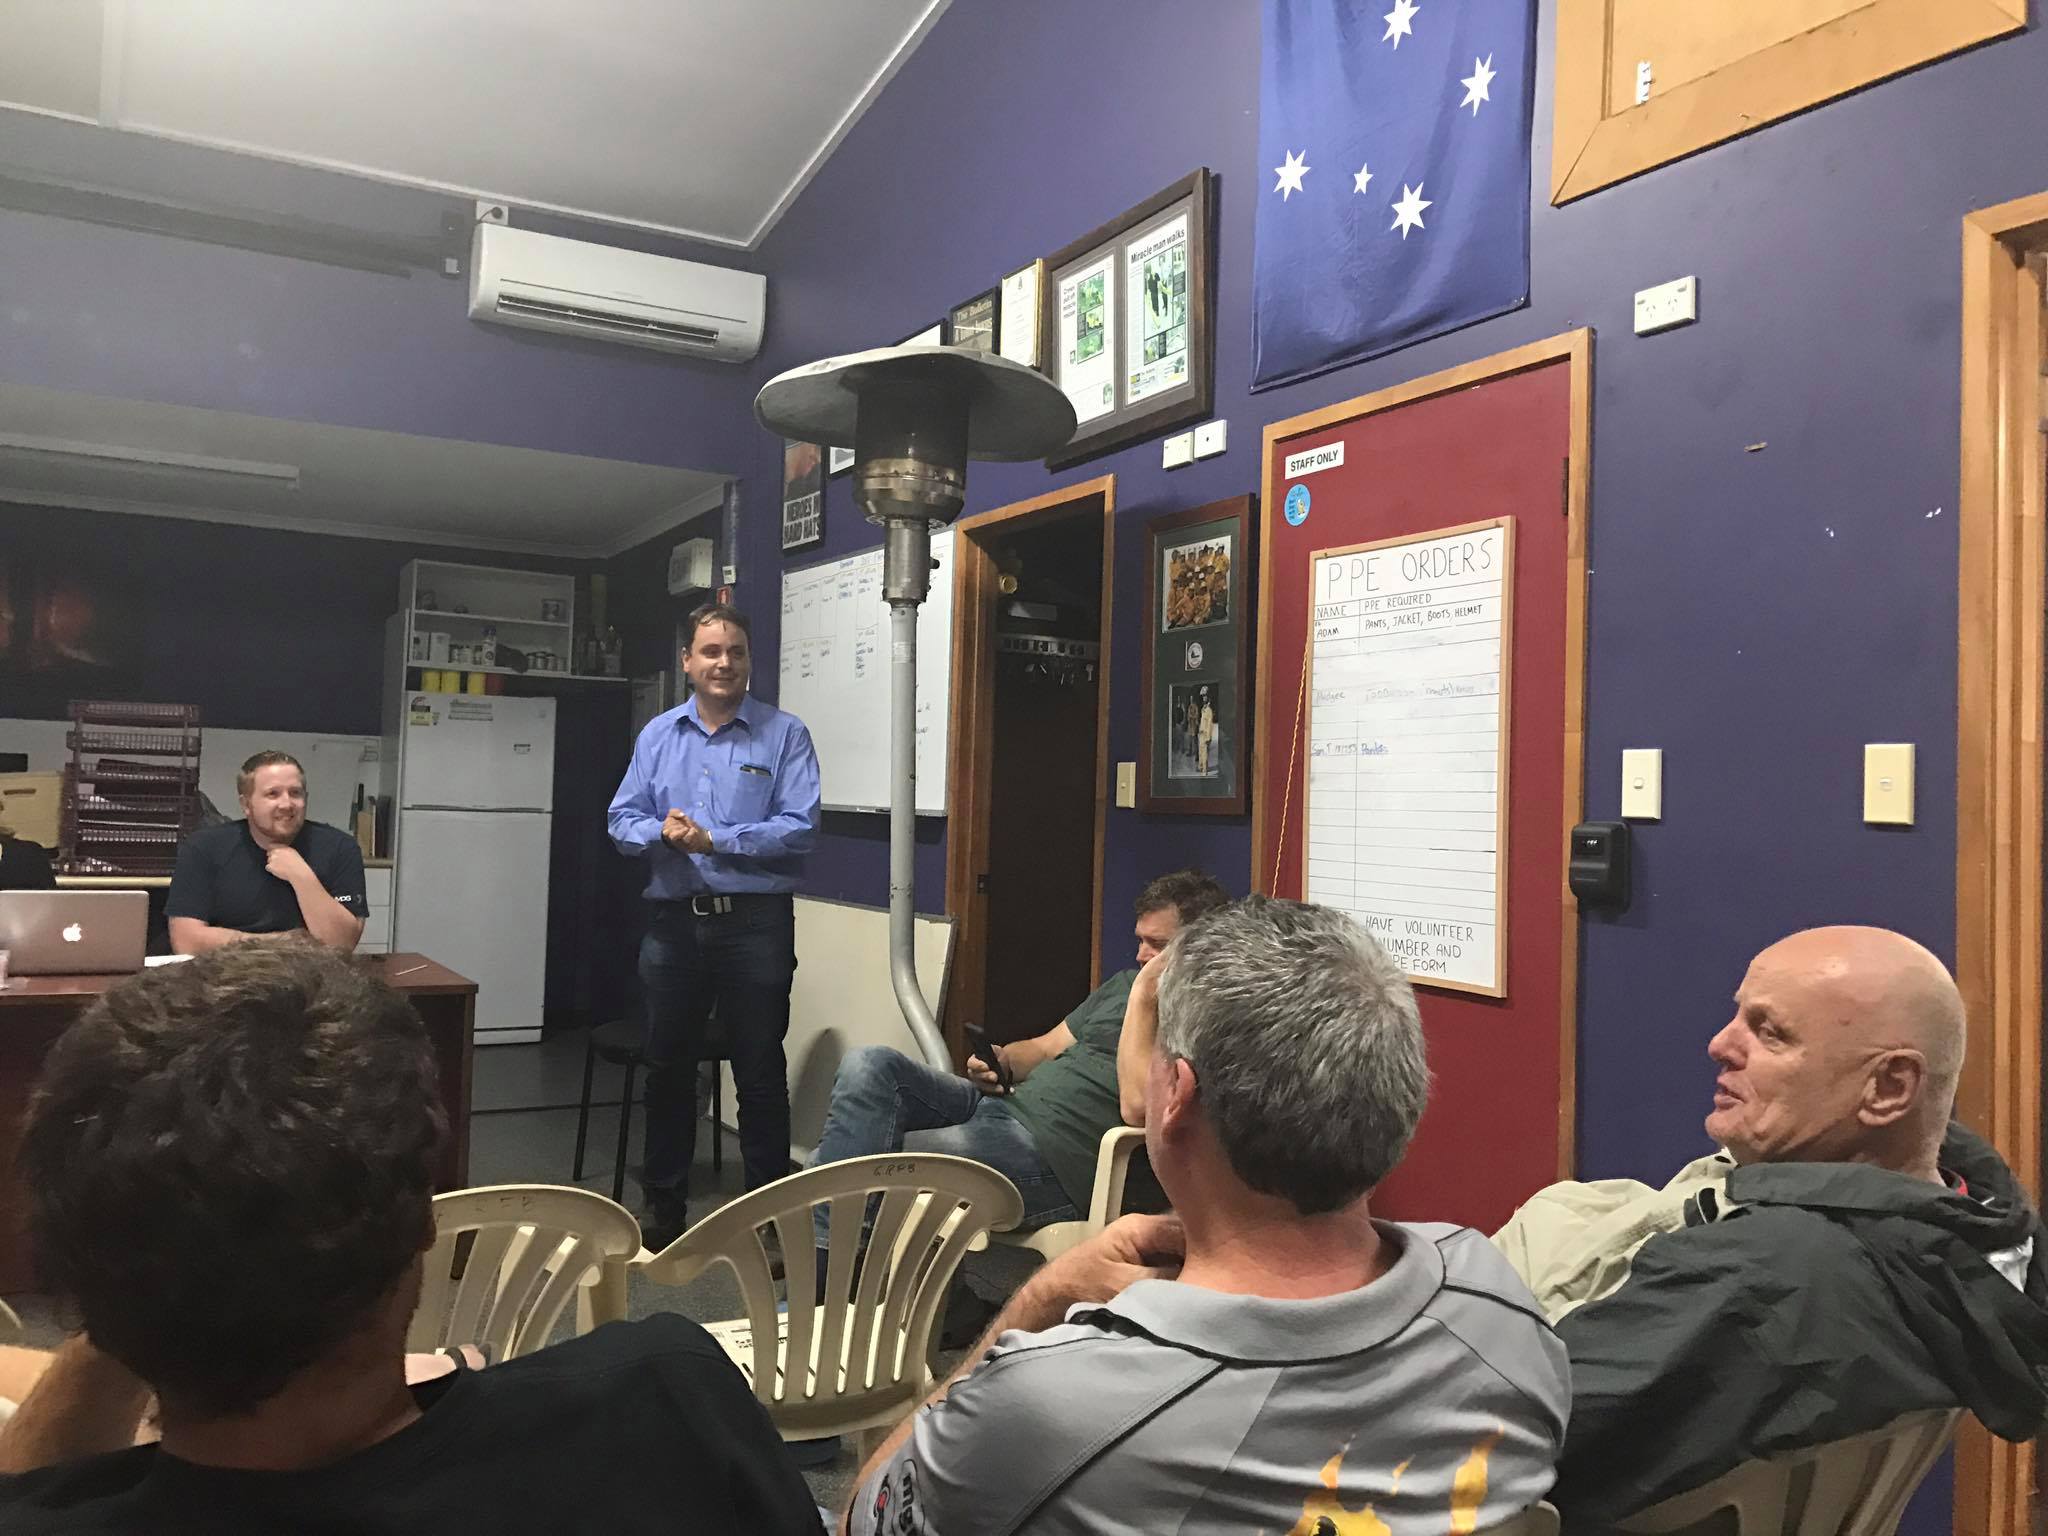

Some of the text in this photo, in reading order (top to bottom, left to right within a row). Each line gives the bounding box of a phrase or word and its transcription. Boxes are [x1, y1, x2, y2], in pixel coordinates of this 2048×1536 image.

[1130, 229, 1185, 264] Miracle man walks
[1290, 450, 1339, 472] STAFF ONLY
[1328, 537, 1494, 600] PPE ORDERS
[1316, 593, 1432, 619] NAME PPE REQUIRED
[1316, 627, 1340, 638] ADAM
[1454, 604, 1482, 618] HELMET
[1365, 915, 1474, 942] HAVE VOLUNTEER
[1436, 943, 1462, 958] AND
[1412, 958, 1447, 973] FORM
